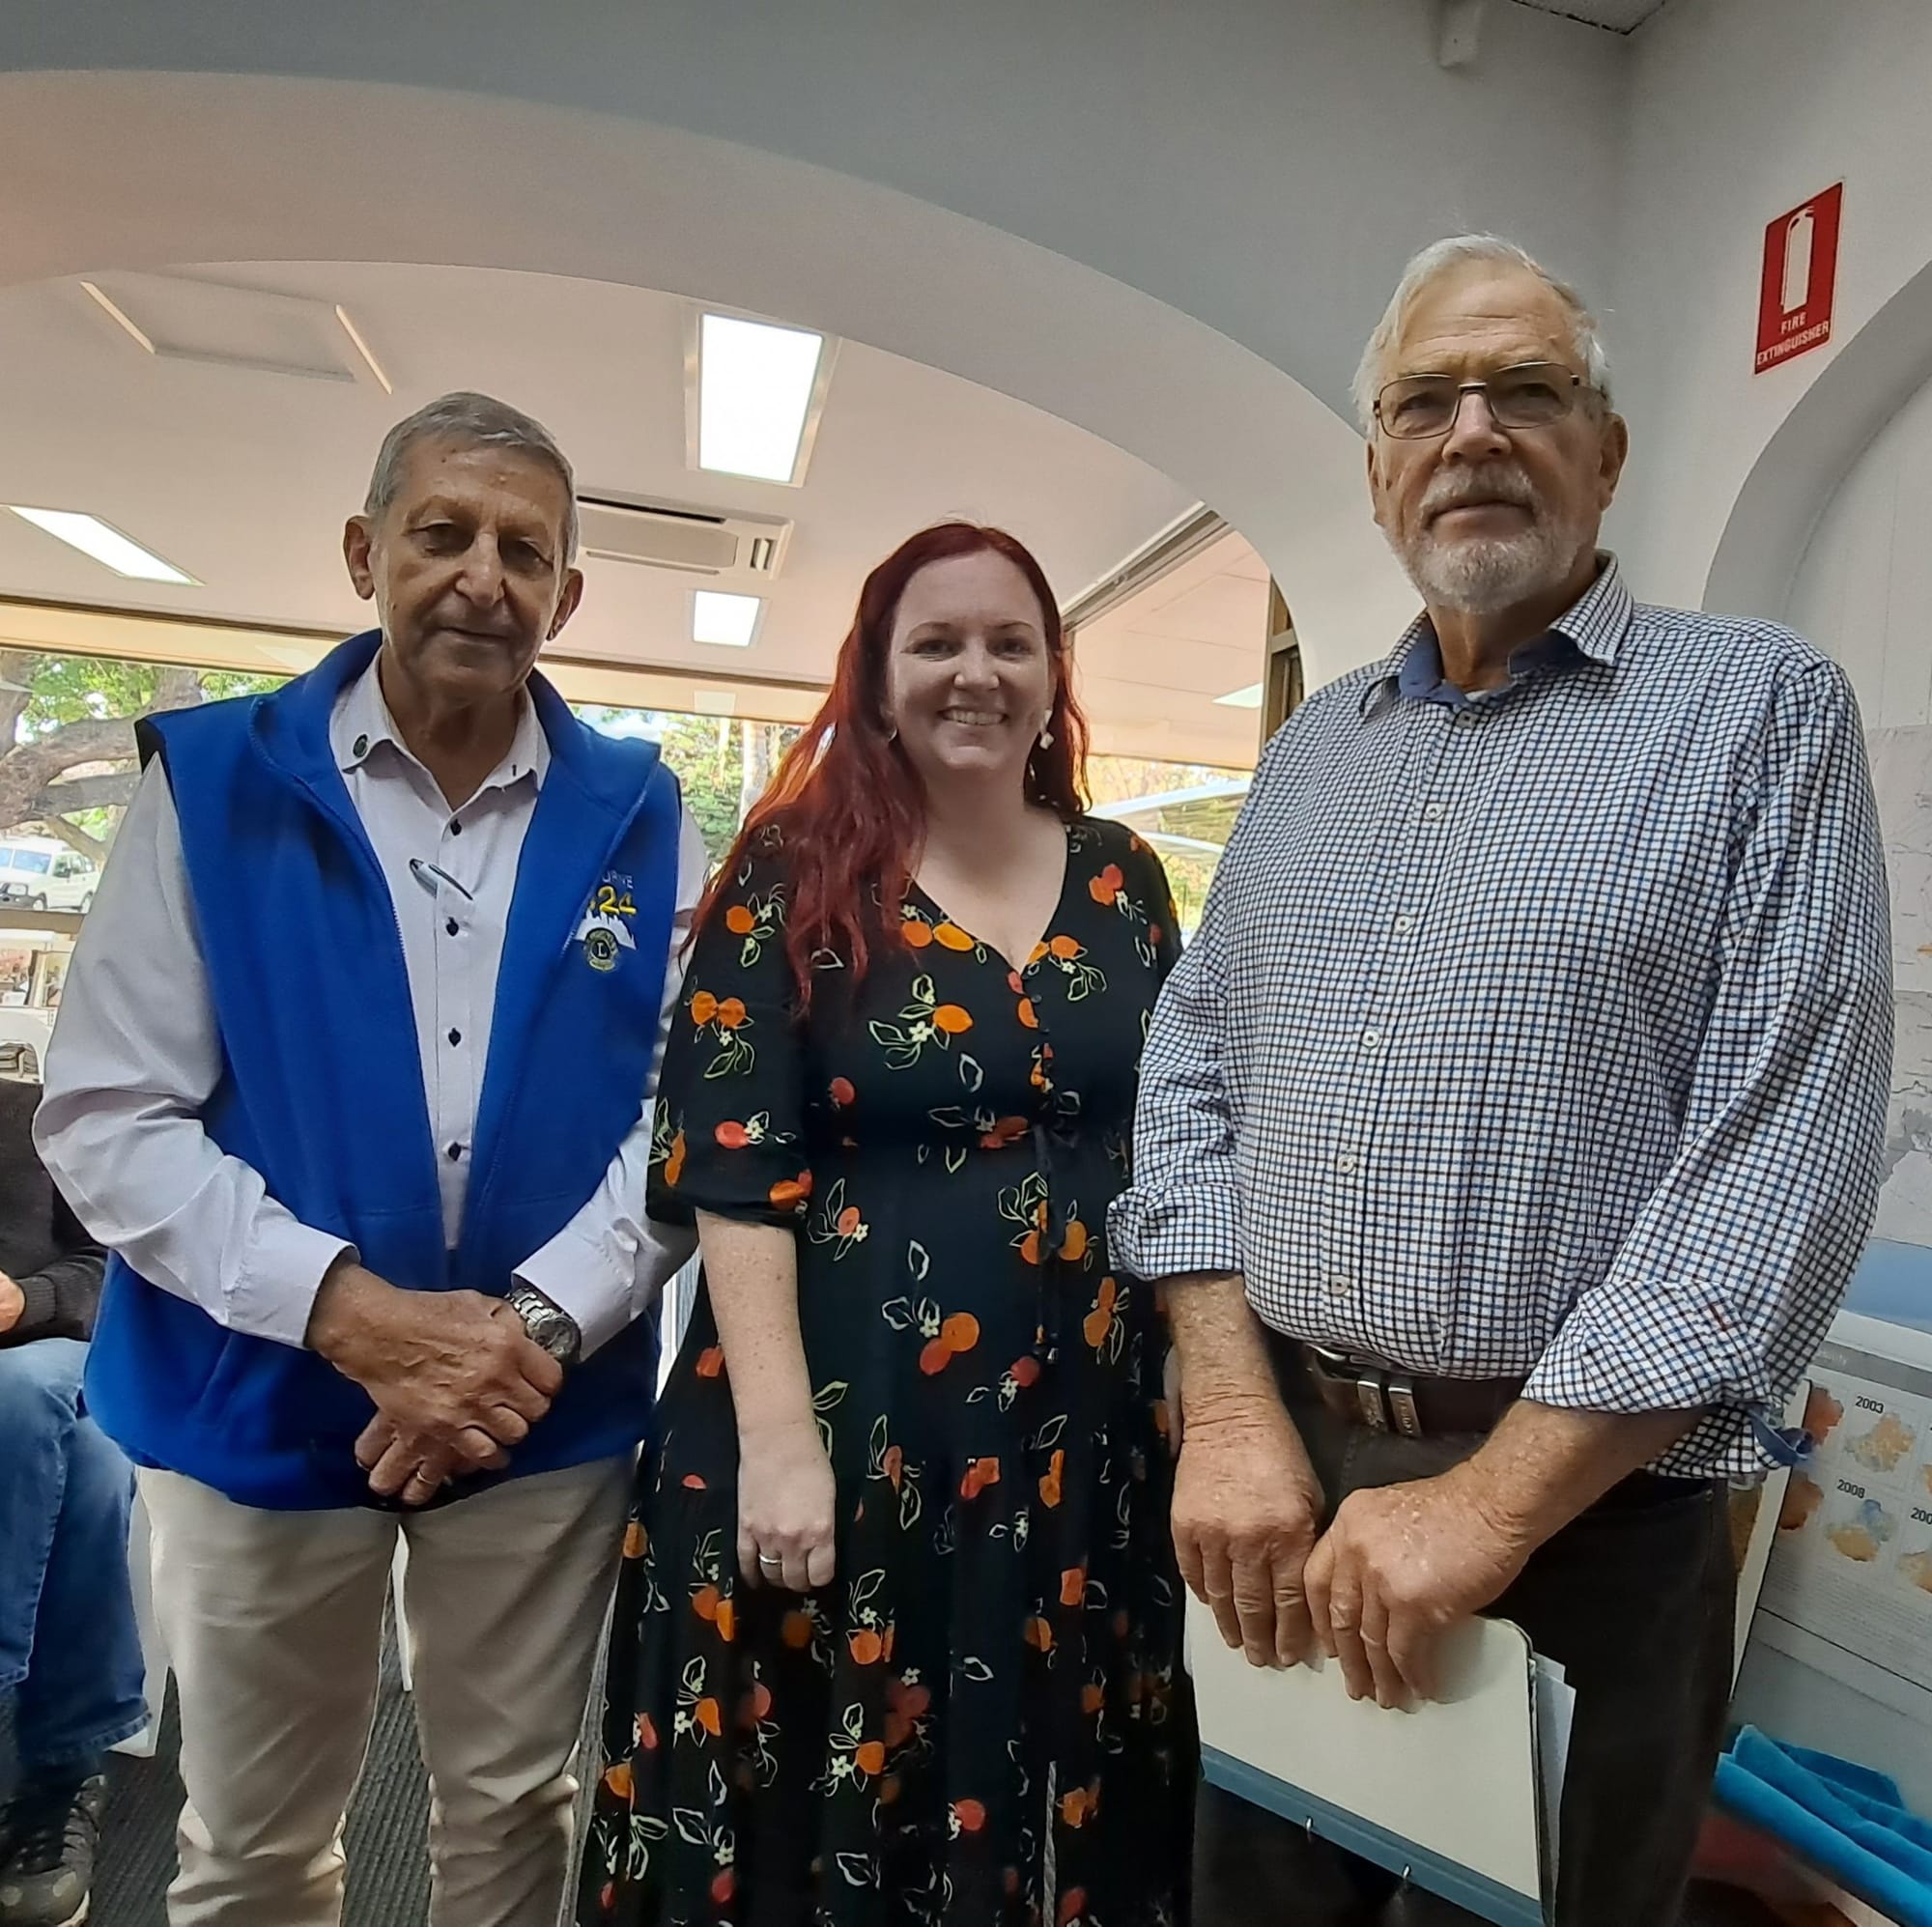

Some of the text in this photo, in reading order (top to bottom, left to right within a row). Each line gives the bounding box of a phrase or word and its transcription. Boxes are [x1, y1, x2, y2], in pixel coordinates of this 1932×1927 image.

[1781, 311, 1806, 335] FIRE
[1756, 320, 1830, 366] EXTINGUISHER
[1855, 1395, 1885, 1414] 2003
[1836, 1479, 1866, 1499] 2008
[1910, 1507, 1932, 1525] 200
